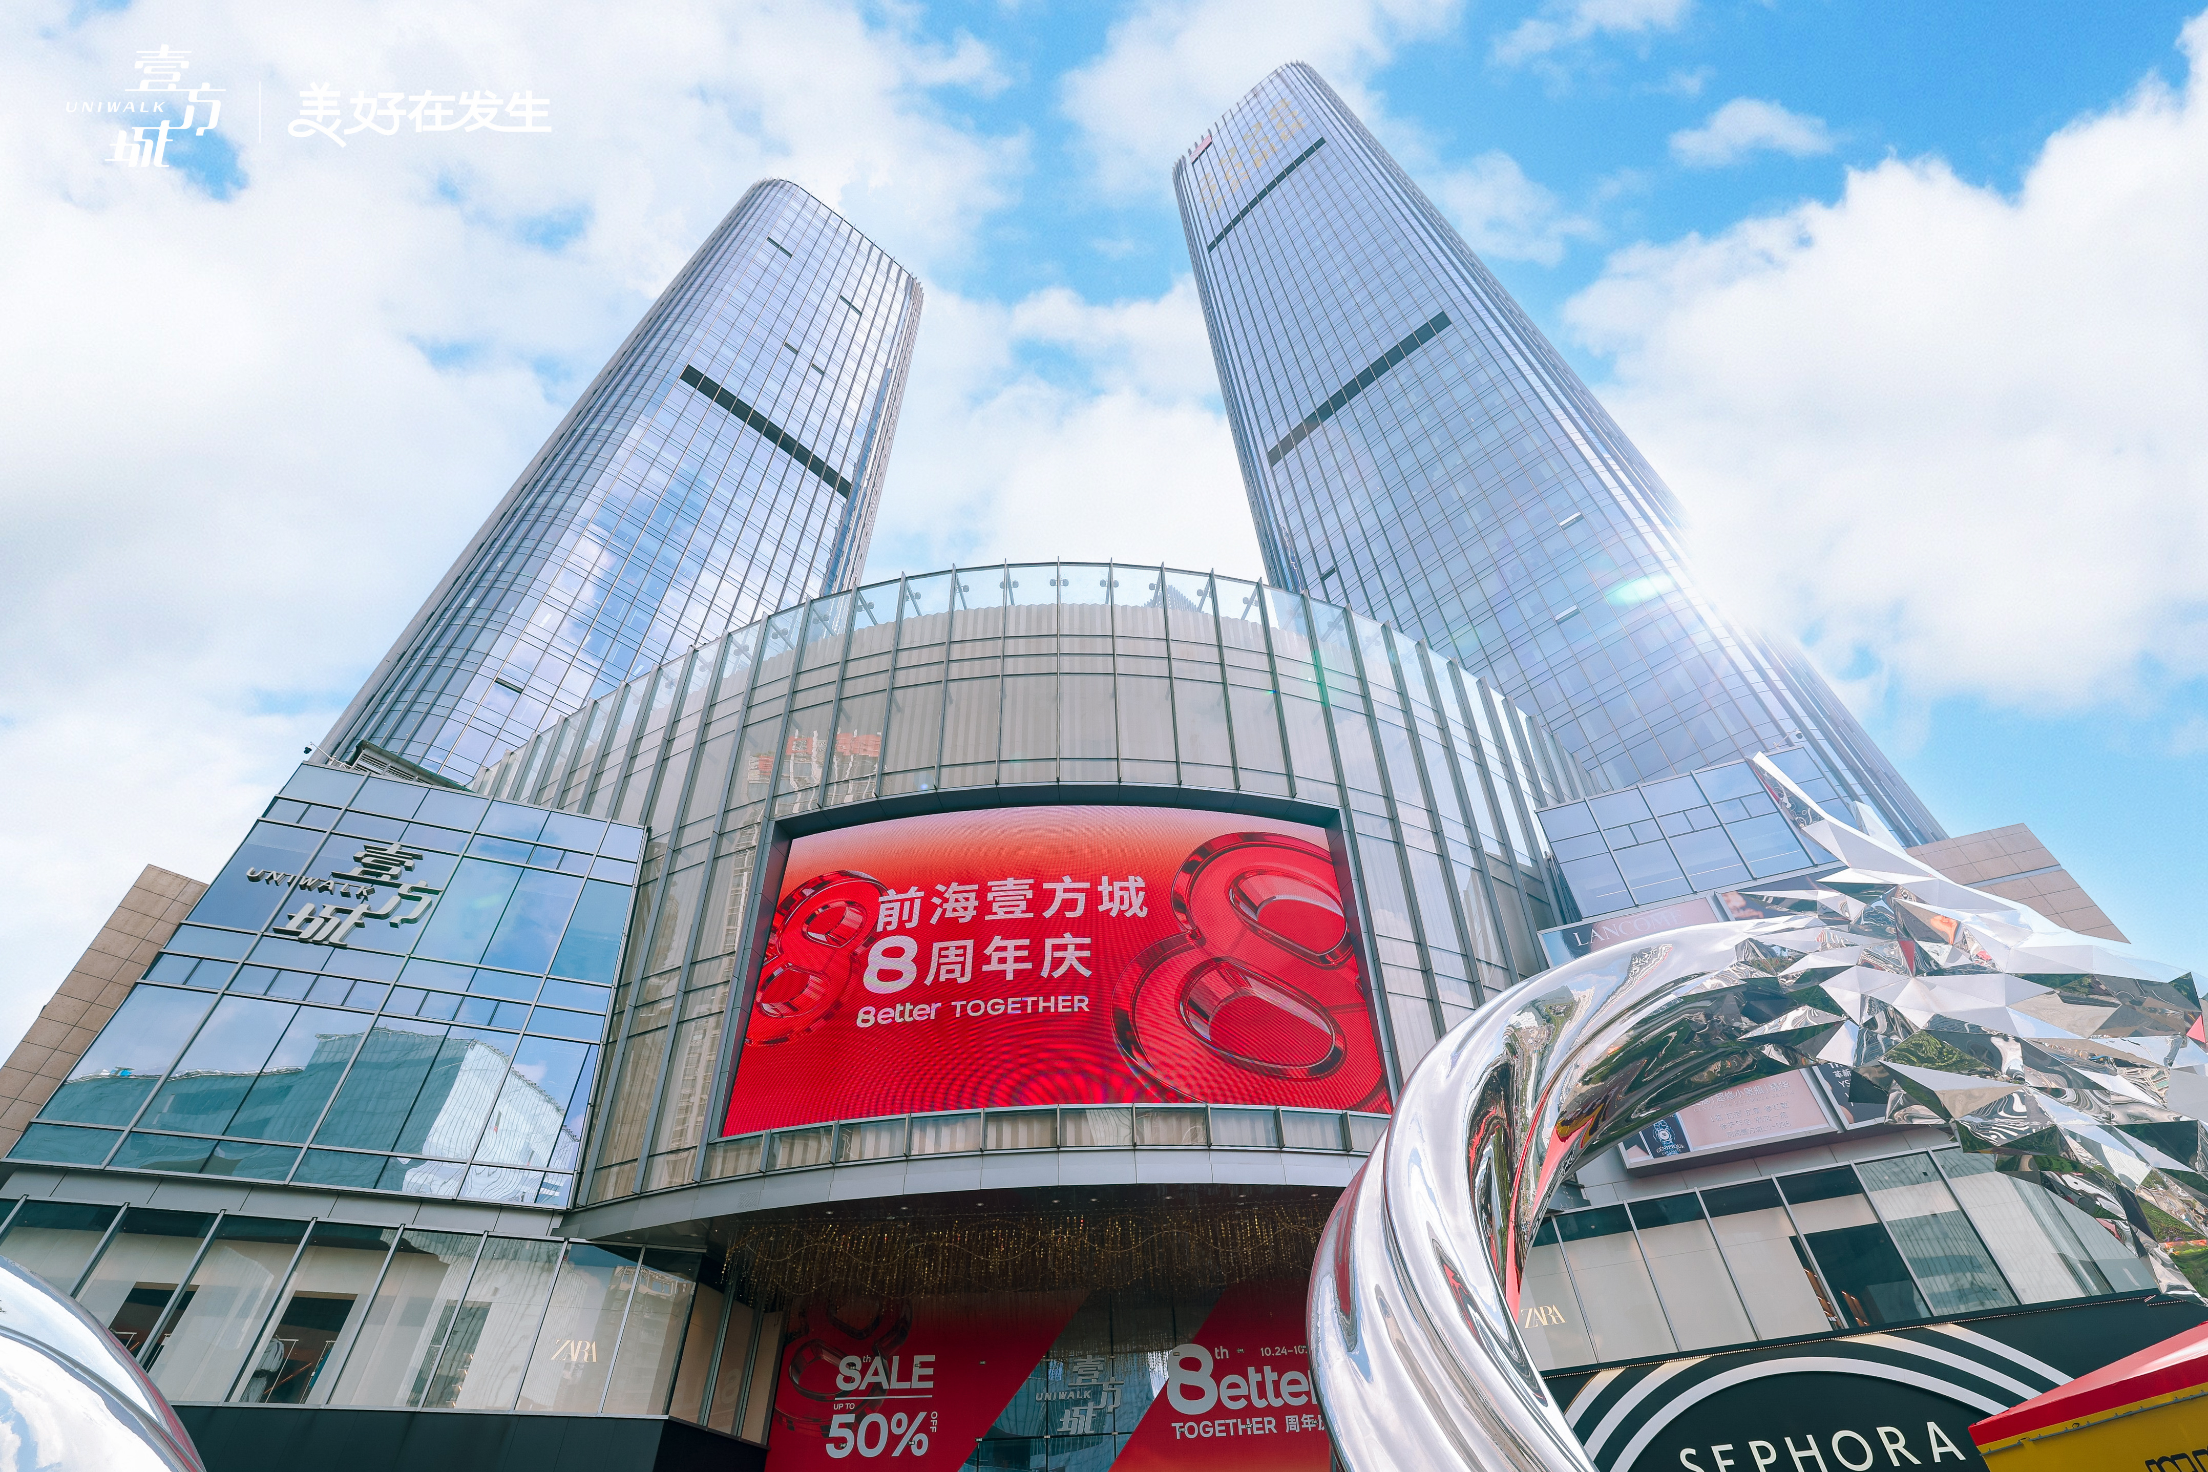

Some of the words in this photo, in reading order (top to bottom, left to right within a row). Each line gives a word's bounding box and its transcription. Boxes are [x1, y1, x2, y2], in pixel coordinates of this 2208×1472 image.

[246, 867, 375, 901] UNIWALK
[876, 875, 1149, 932] 前海壹方城
[1572, 909, 1686, 947] LANCOME
[862, 932, 1092, 994] 8周年庆
[951, 996, 1090, 1018] TOGETHER
[1520, 1304, 1567, 1329] ZARA
[551, 1339, 598, 1363] ZARA
[845, 1402, 856, 1410] TO
[1035, 1390, 1092, 1402] UNIWALK
[929, 1411, 938, 1433] OFF
[1171, 1416, 1277, 1440] TOGETHER
[825, 1411, 929, 1459] 50%
